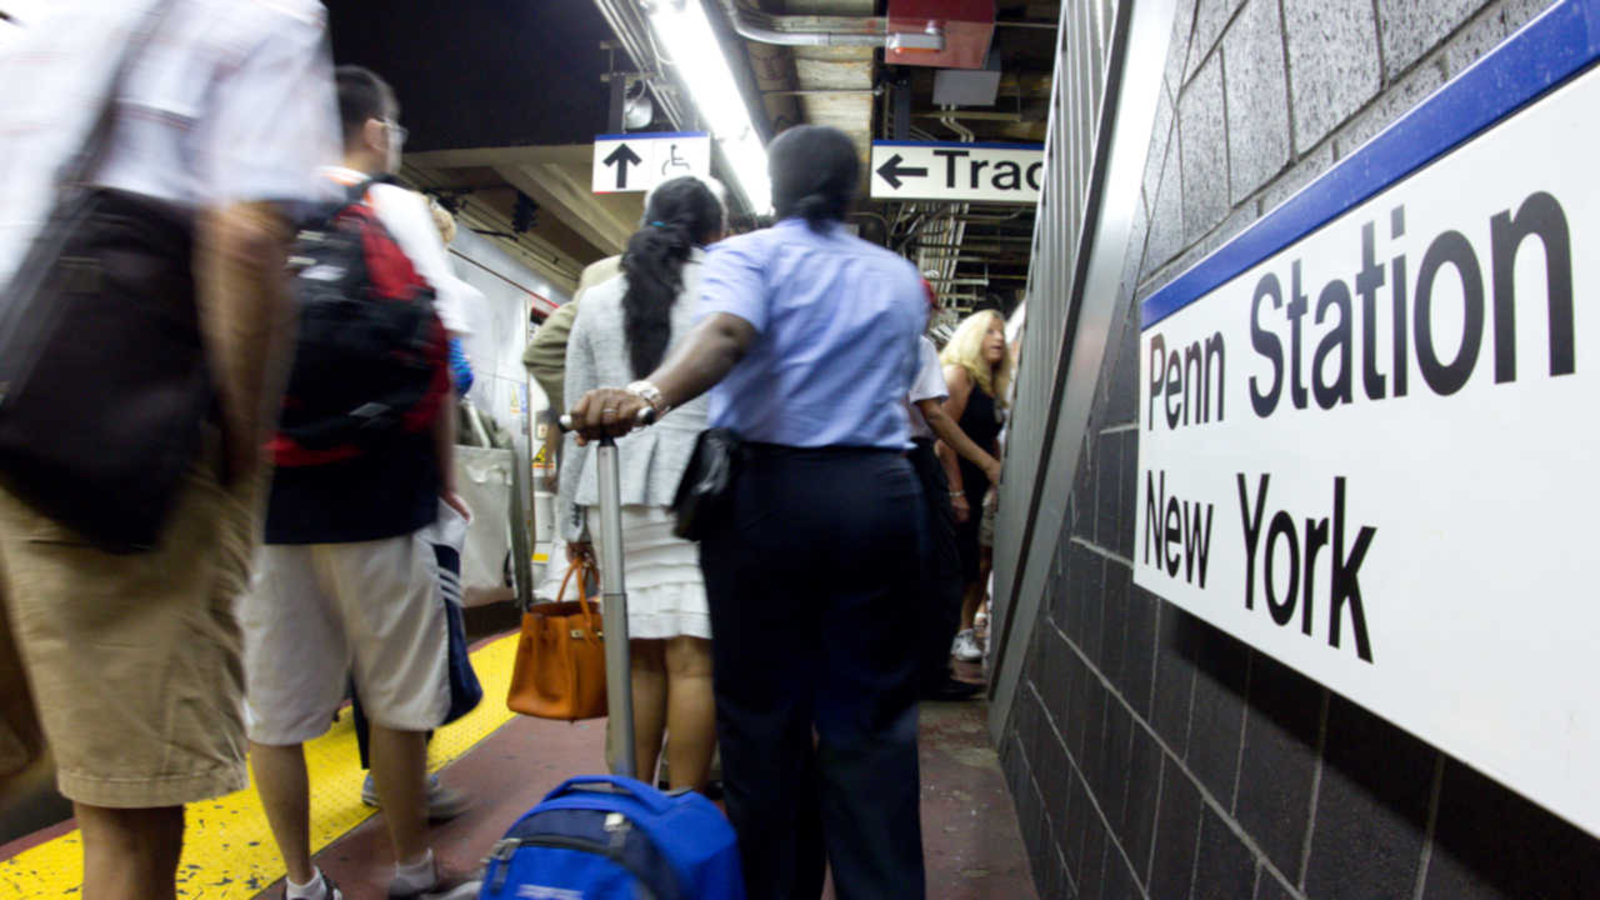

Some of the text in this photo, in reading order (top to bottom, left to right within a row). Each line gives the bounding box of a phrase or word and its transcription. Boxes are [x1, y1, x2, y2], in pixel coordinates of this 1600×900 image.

[933, 149, 1043, 191] Trac
[1149, 191, 1576, 431] Penn Station
[1145, 470, 1377, 664] New York
